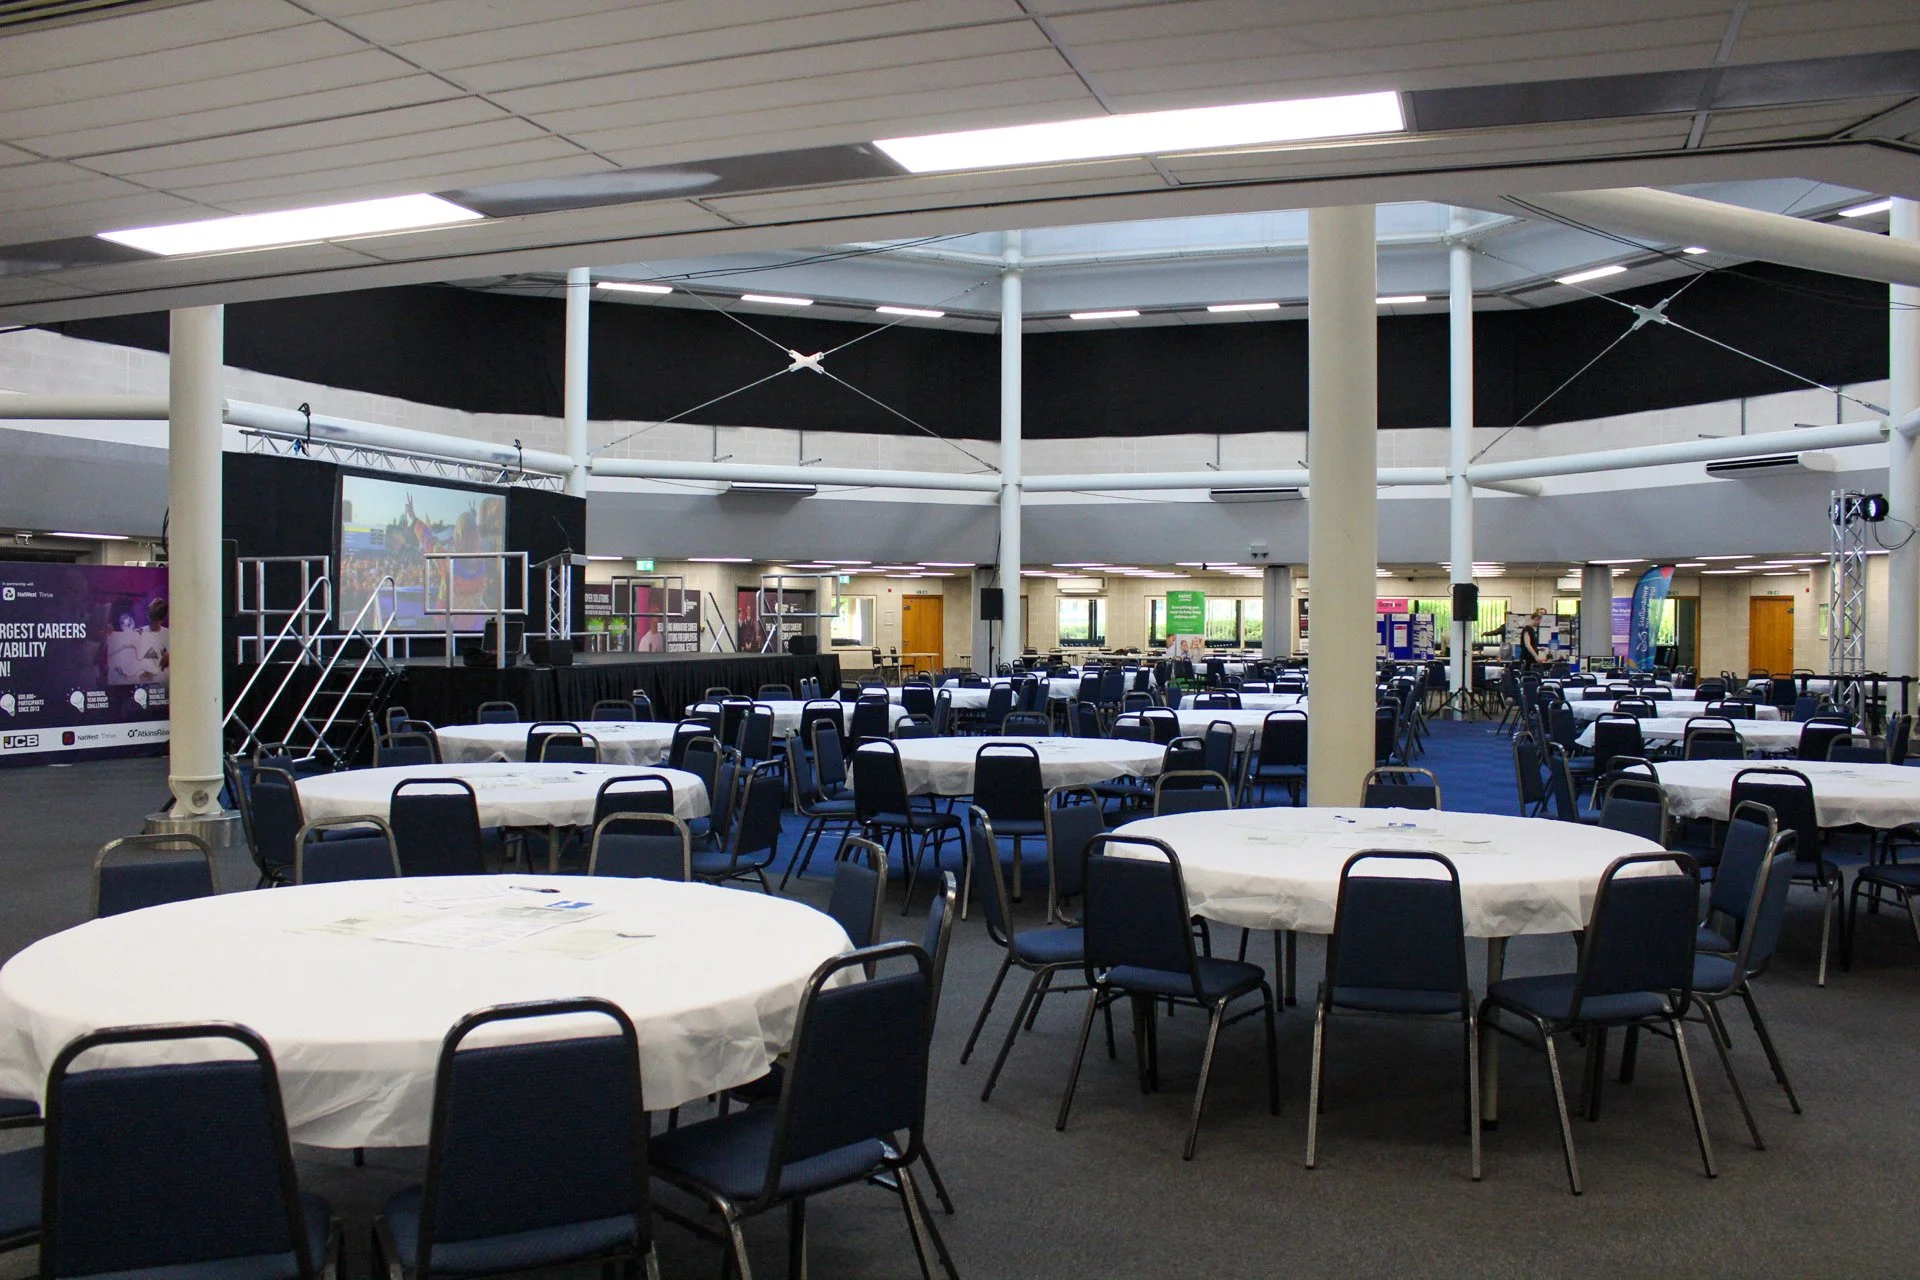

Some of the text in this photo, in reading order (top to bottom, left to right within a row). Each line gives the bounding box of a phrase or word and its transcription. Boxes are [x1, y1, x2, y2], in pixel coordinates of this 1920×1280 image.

[1638, 586, 1649, 627] Staffordshire
[37, 623, 87, 639] CAREERS
[4, 735, 38, 748] JCB
